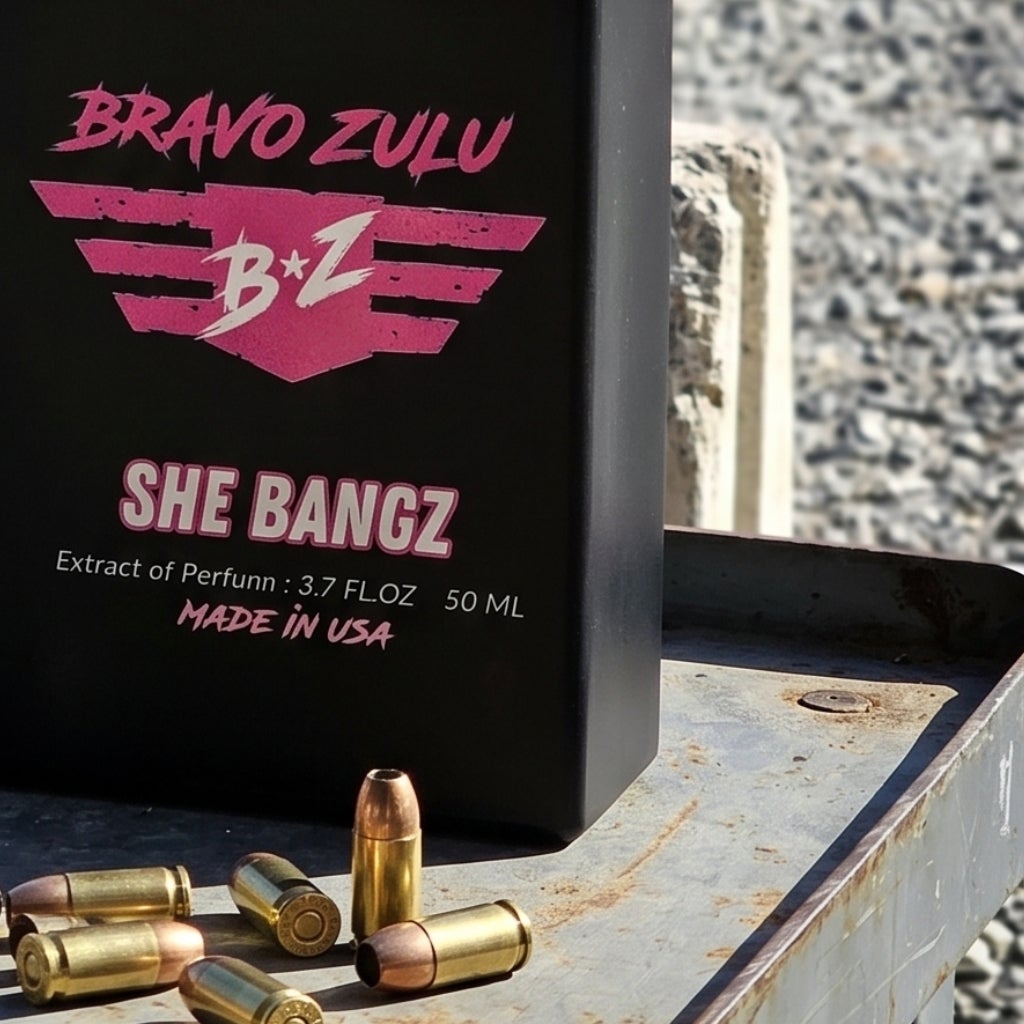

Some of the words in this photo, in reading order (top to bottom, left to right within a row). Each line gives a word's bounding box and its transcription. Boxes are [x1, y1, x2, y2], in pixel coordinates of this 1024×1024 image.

[48, 81, 306, 170] BRAVO
[308, 106, 514, 188] ZULU
[118, 458, 240, 538] SHE
[247, 470, 460, 559] BANGZ
[56, 549, 142, 578] Extract
[149, 560, 177, 582] of
[298, 574, 337, 597] 3.7
[444, 589, 478, 612] 50
[485, 593, 525, 619] ML
[177, 598, 279, 635] MADE
[327, 617, 395, 650] USA
